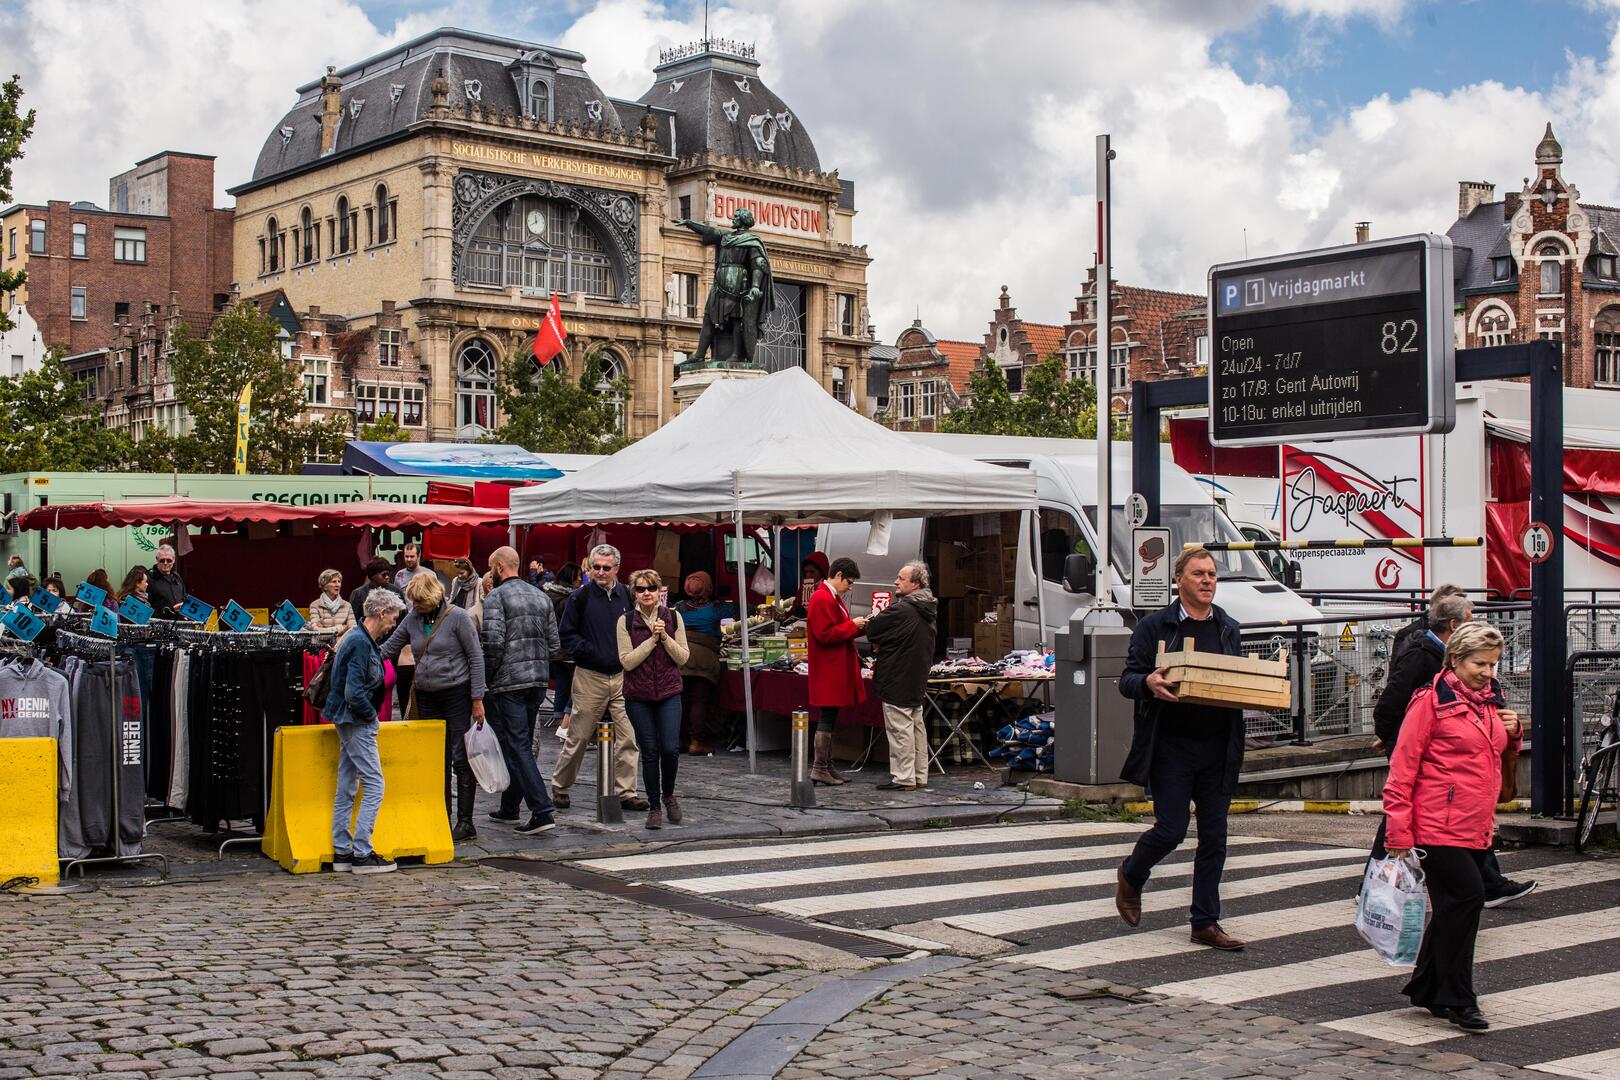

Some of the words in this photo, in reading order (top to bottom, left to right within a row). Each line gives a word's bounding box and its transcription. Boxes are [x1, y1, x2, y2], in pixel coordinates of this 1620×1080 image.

[452, 143, 527, 164] SOCIALISTISCHE
[532, 154, 643, 182] WERKERSVEREENIGINGEN
[1225, 285, 1238, 306] P
[1269, 271, 1366, 300] Vrijdagmarkt
[512, 317, 540, 330] ONS
[561, 321, 586, 333] UIS
[1381, 319, 1418, 354] 82
[1221, 335, 1254, 355] Open
[1221, 355, 1263, 376] 24u/24
[1274, 351, 1302, 370] 7d/7
[1222, 386, 1237, 399] zo
[1241, 379, 1270, 398] 17/9:
[1275, 377, 1307, 394] Gent
[1310, 370, 1359, 392] Autovrij
[1222, 404, 1267, 423] 10-18u:
[1272, 400, 1306, 419] enkel
[1310, 396, 1362, 419] uitrijden
[1290, 467, 1417, 533] Jaspaert
[146, 527, 172, 536] 1967
[1289, 547, 1366, 560] Kippenspeciaalzaak
